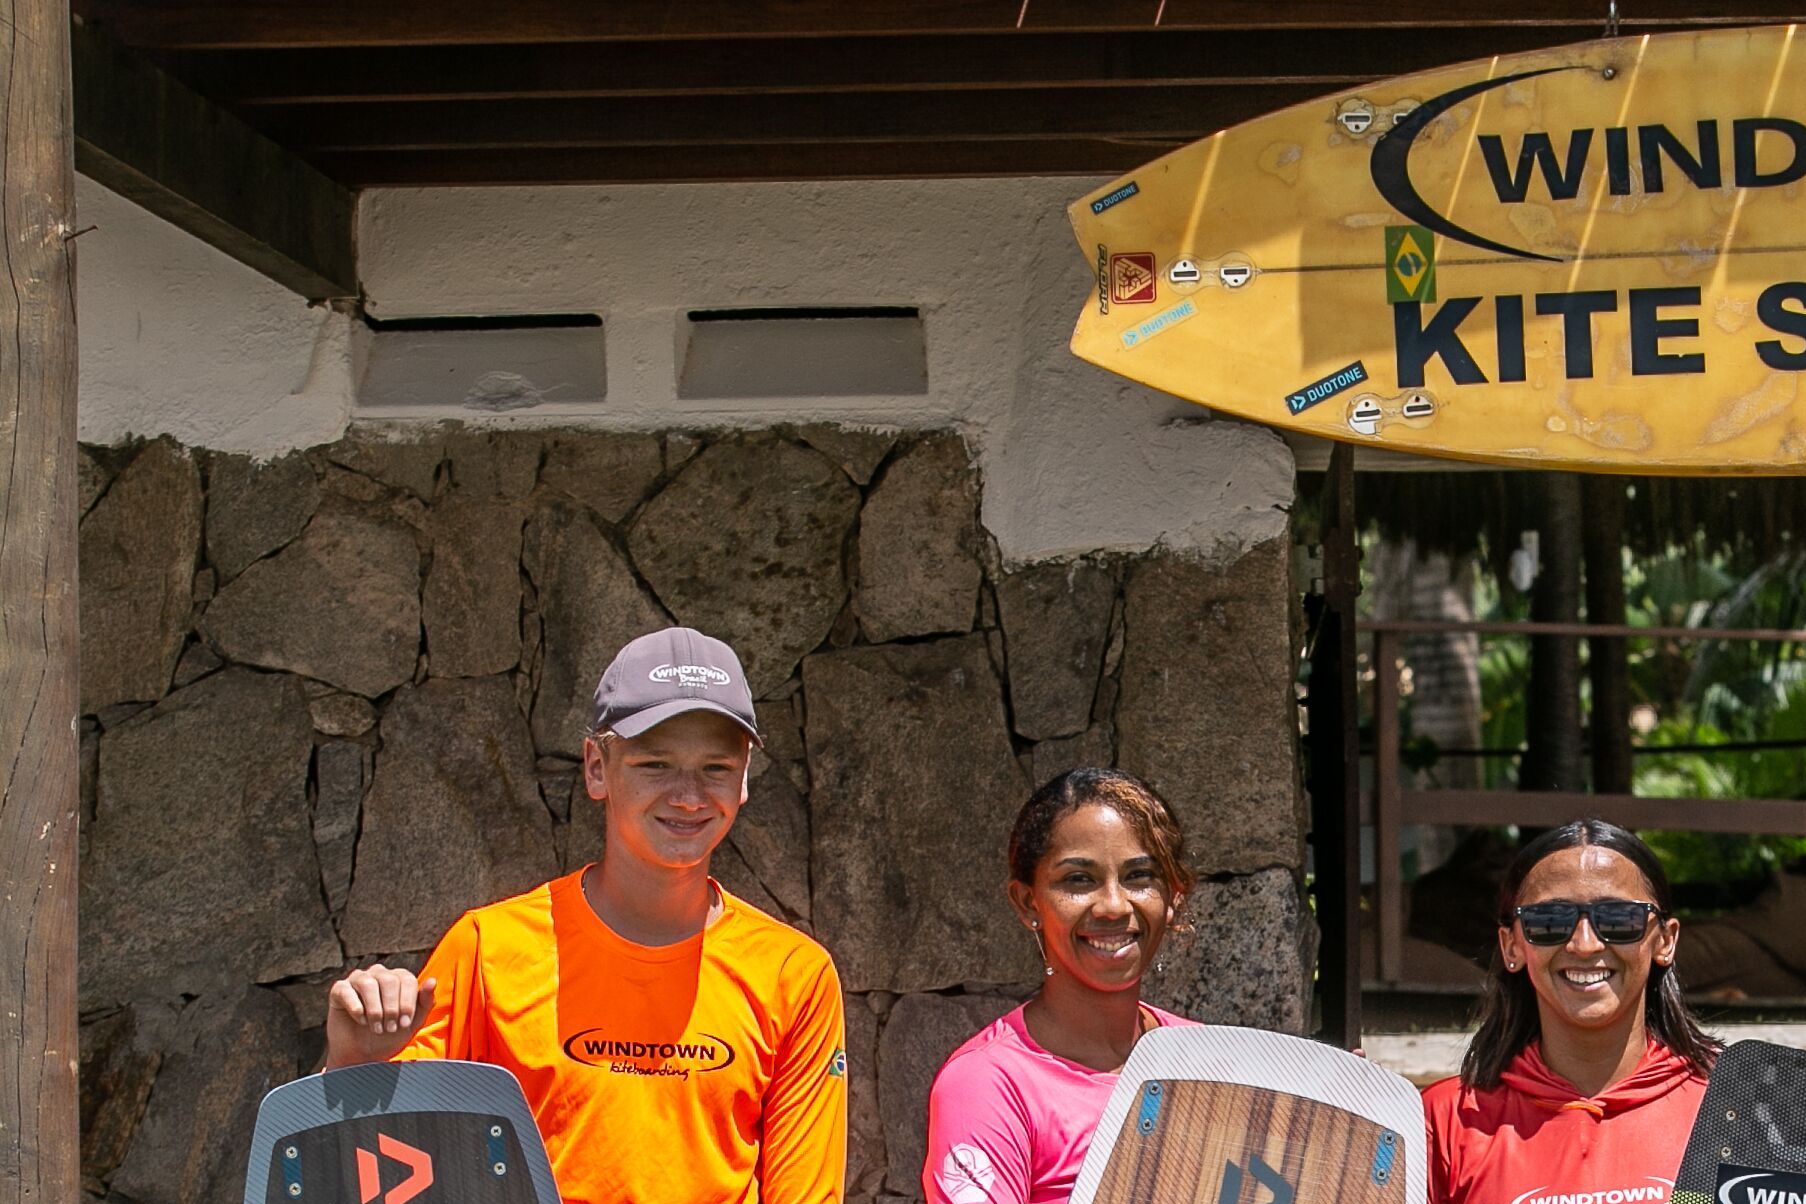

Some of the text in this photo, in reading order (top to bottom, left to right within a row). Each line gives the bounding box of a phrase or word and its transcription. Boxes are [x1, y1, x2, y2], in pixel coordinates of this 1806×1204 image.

[1104, 185, 1137, 207] DUOTONE
[1394, 286, 1706, 389] KITE
[1307, 367, 1364, 402] DUOTONE
[656, 665, 725, 681] WINDTOWN
[583, 1039, 716, 1061] WINDTOWN
